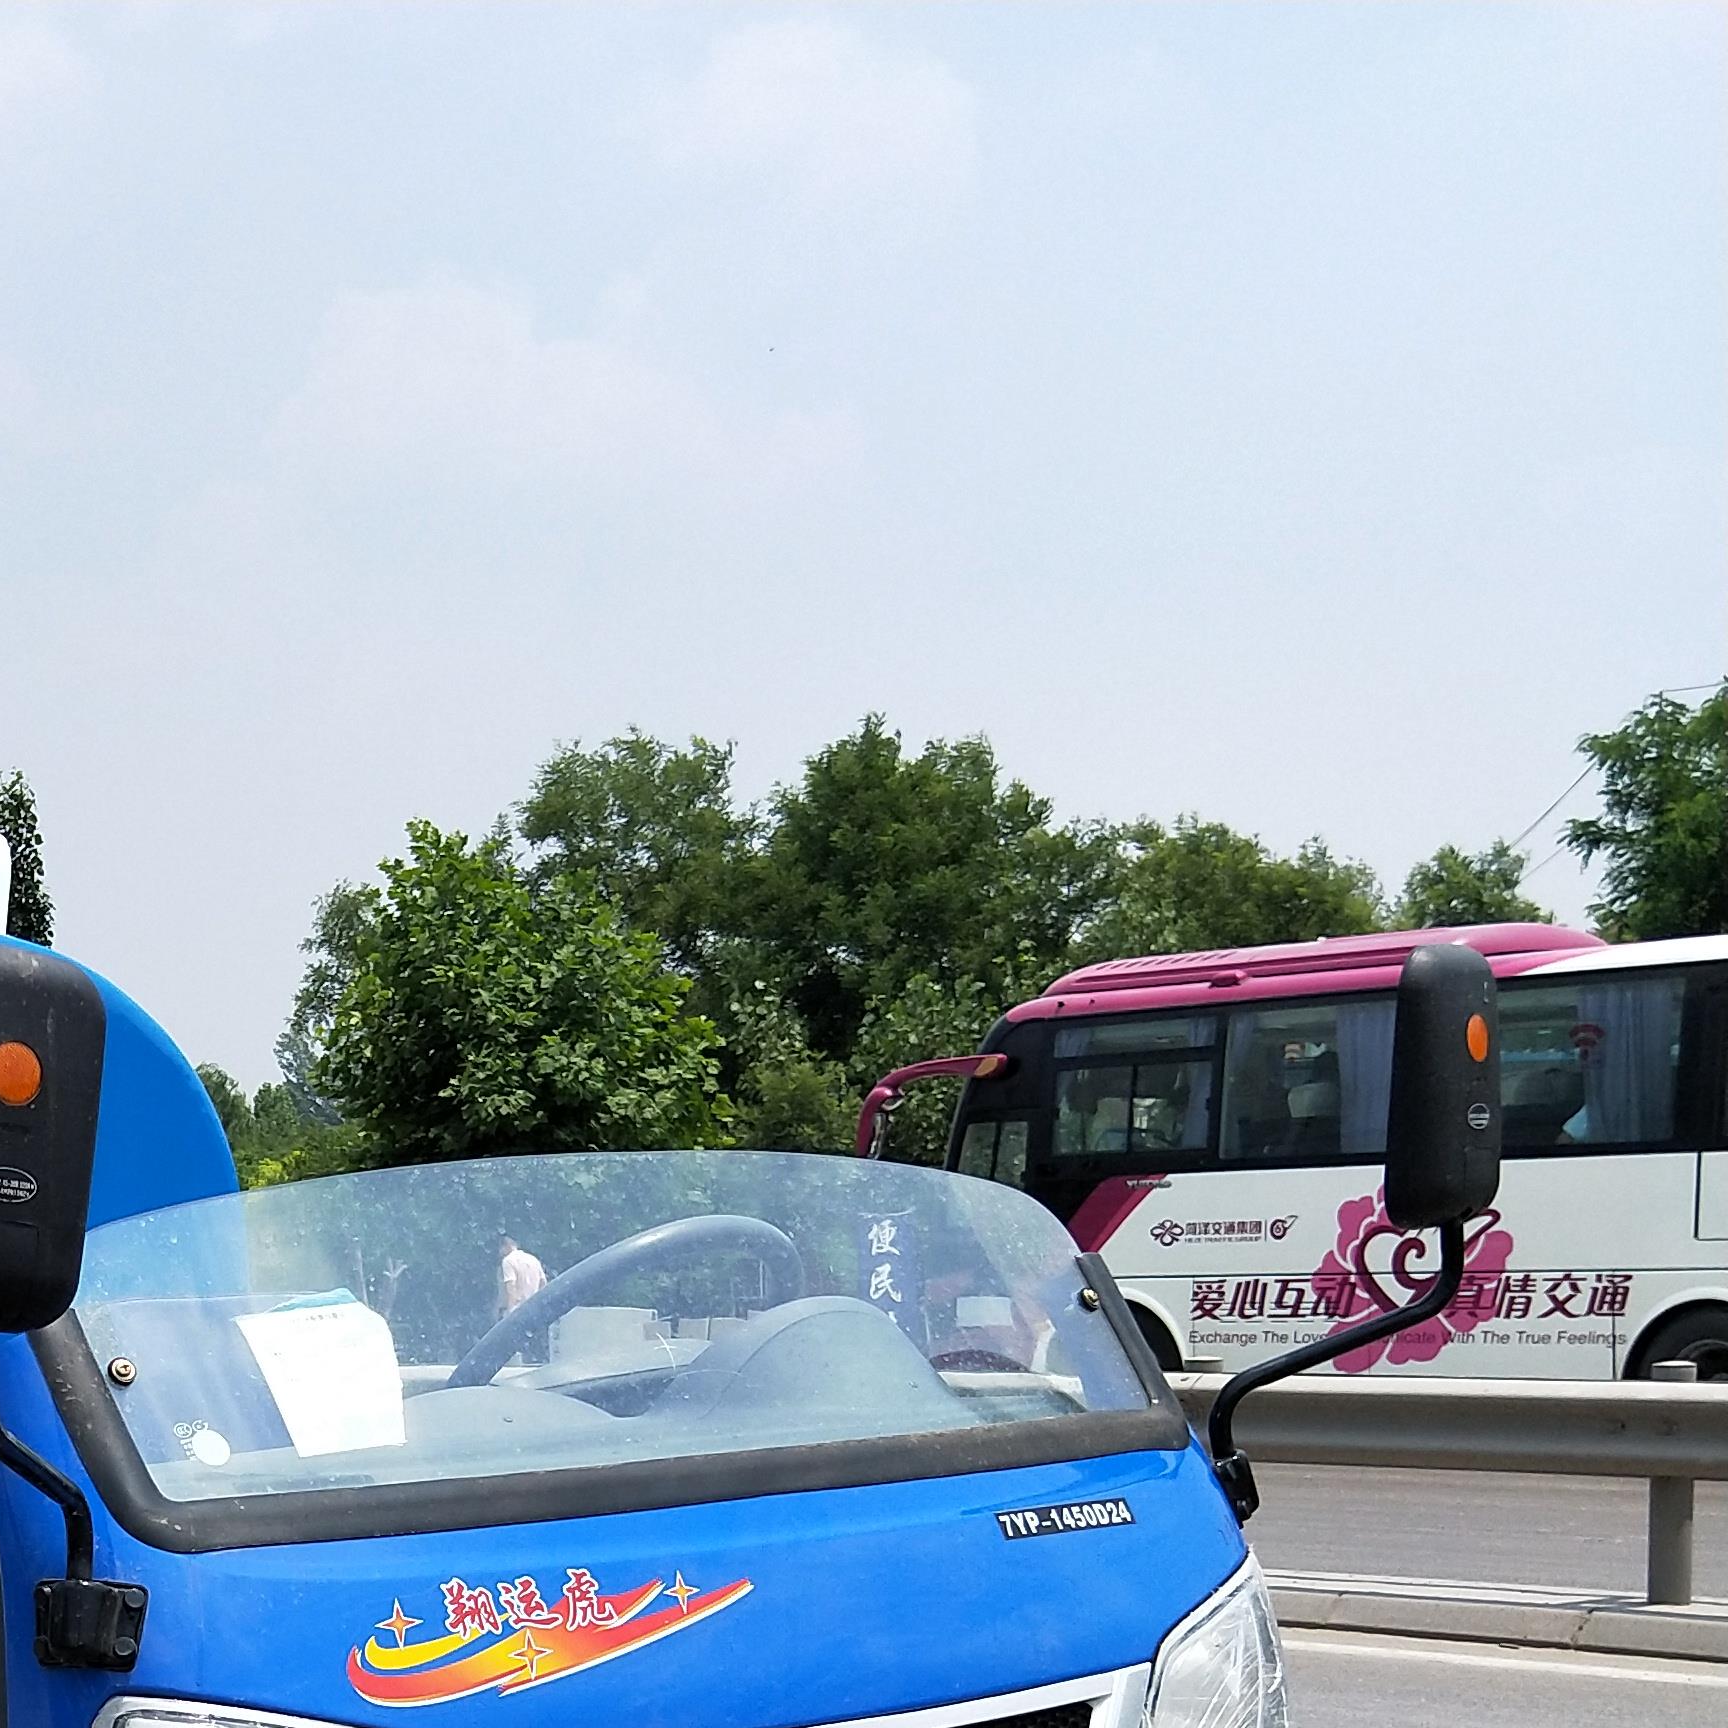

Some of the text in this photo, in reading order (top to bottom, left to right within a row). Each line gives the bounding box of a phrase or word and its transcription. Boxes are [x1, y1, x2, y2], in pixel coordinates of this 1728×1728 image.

[1190, 1273, 1633, 1321] 爱心互动 真情交通
[1189, 1330, 1257, 1345] Exchange
[1263, 1330, 1289, 1344] The
[1441, 1331, 1476, 1344] With
[1481, 1331, 1511, 1345] The
[1517, 1331, 1552, 1345] True
[1557, 1331, 1627, 1348] Feelings
[998, 1501, 1133, 1538] 7YP-1450D24
[440, 1568, 620, 1639] 翔运虎
